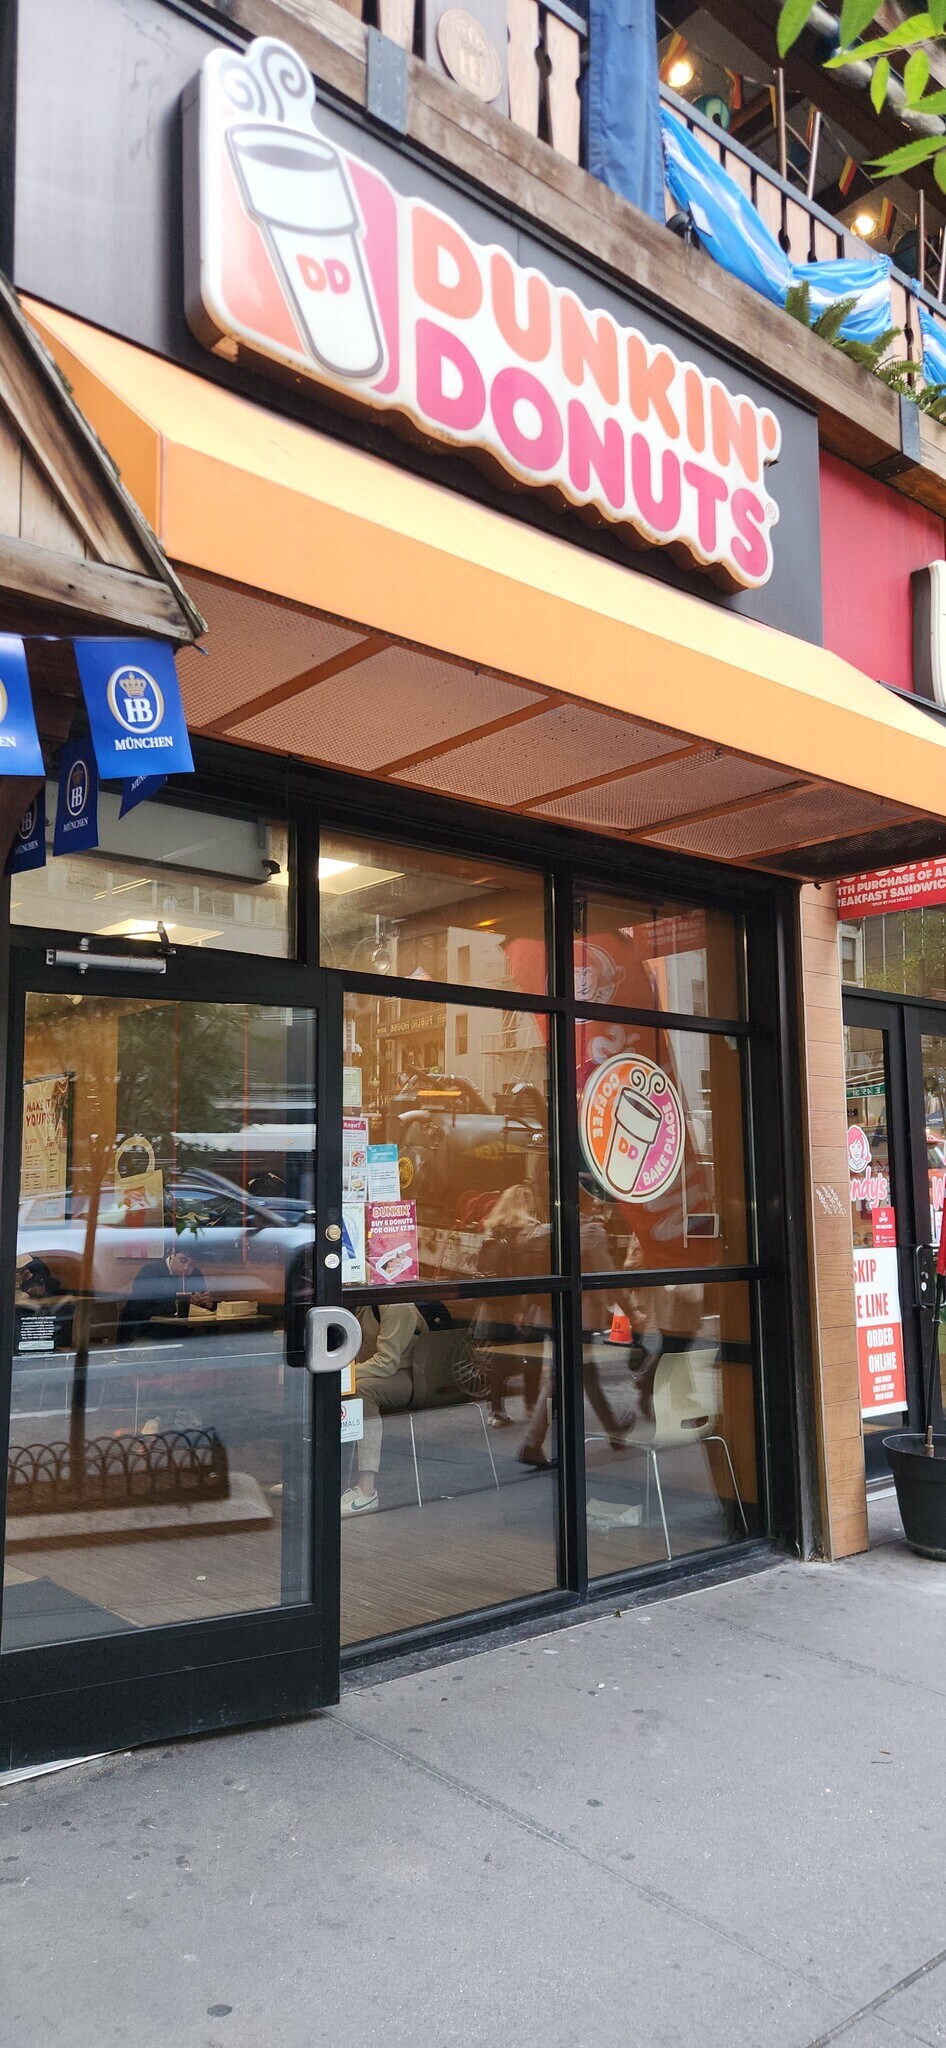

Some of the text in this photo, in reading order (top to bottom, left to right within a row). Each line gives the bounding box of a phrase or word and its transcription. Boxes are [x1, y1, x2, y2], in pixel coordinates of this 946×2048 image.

[296, 254, 351, 295] DD
[412, 206, 777, 483] DUNKIN'
[415, 317, 769, 578] DONUTS
[123, 698, 153, 723] HB
[114, 736, 173, 751] MÜNCHEN
[71, 786, 83, 808] HB
[63, 817, 88, 833] MÜNCHEN
[837, 885, 855, 896] ITH
[857, 873, 915, 892] PURCHASE
[917, 869, 933, 881] OF
[592, 1073, 620, 1139] COFFEE
[618, 1137, 639, 1160] DD
[642, 1102, 676, 1186] BAKE PLACE
[865, 1293, 889, 1318] LINE
[866, 1327, 894, 1349] ORDER
[868, 1352, 897, 1374] ONLINE
